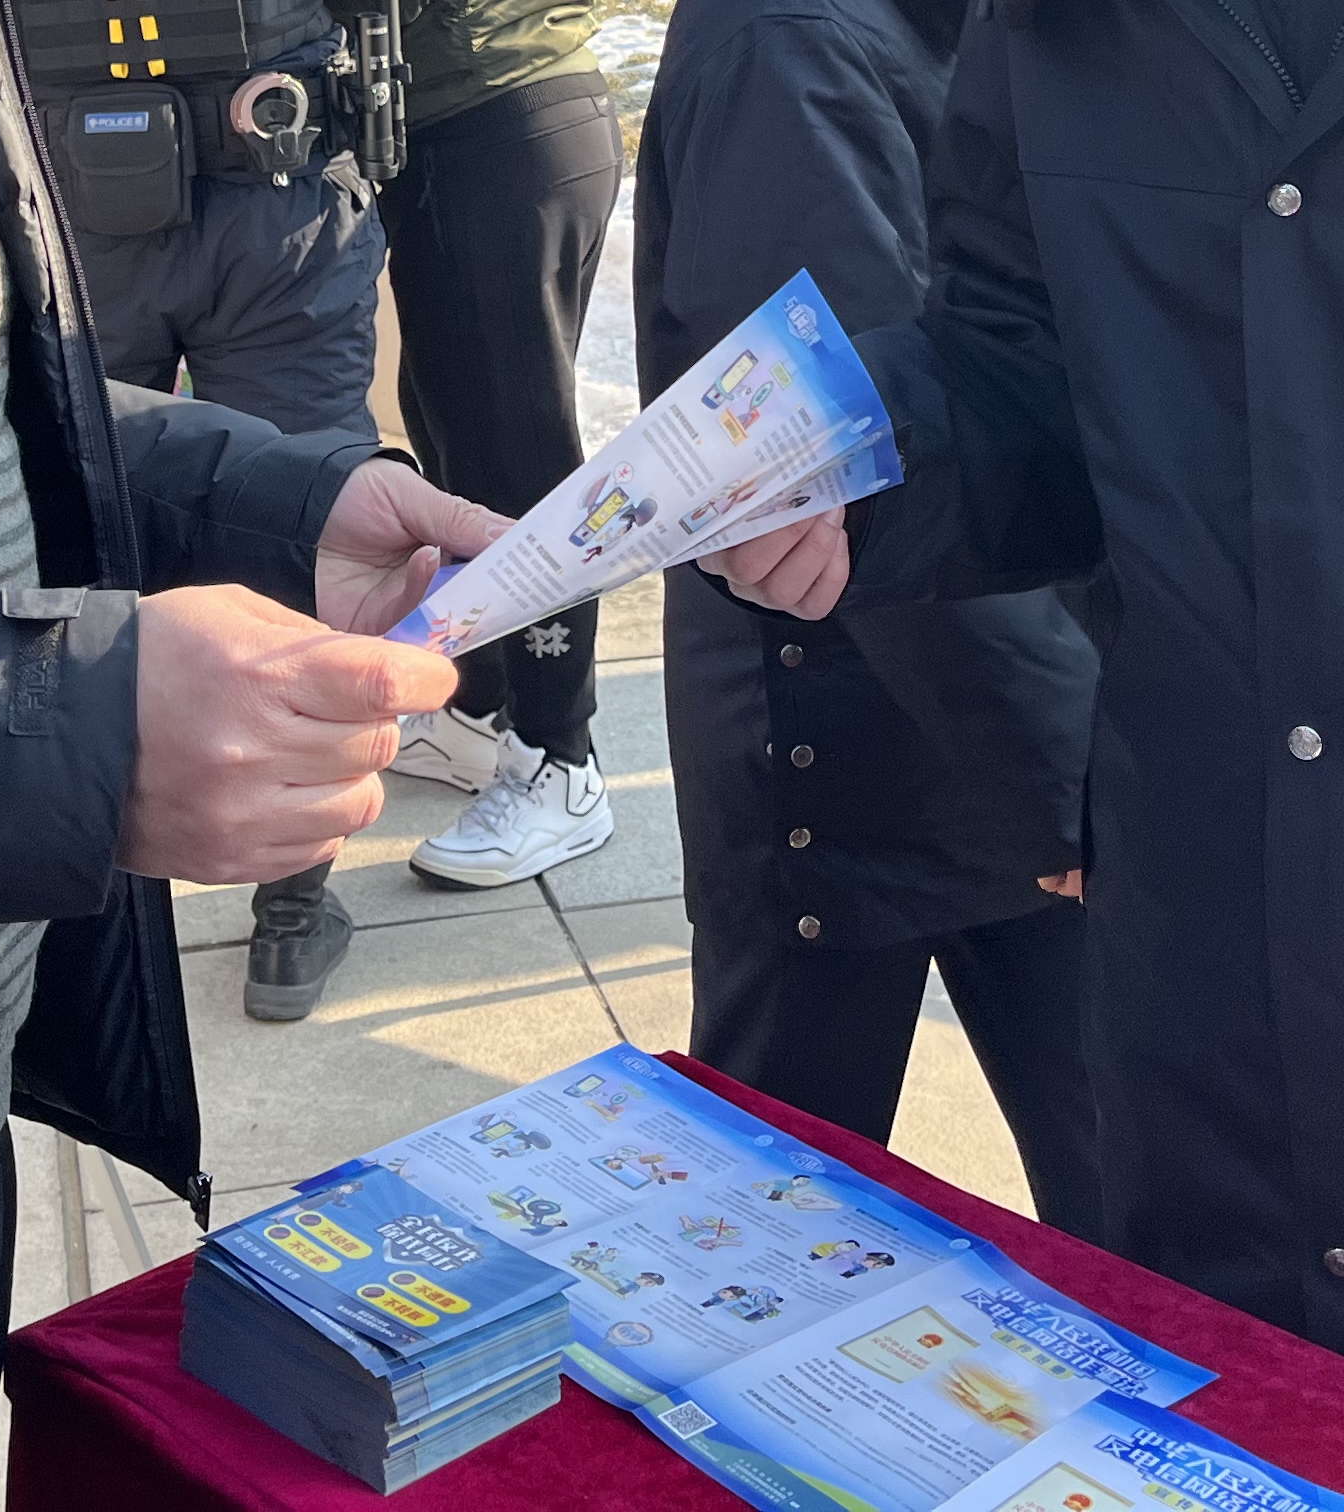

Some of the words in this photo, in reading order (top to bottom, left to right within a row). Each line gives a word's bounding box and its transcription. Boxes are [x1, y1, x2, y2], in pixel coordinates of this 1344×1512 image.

[964, 1290, 1146, 1397] 反电信网络诈骗法
[999, 1286, 1158, 1381] 中华人民共和国
[1133, 1428, 1318, 1512] 中华人民共和
